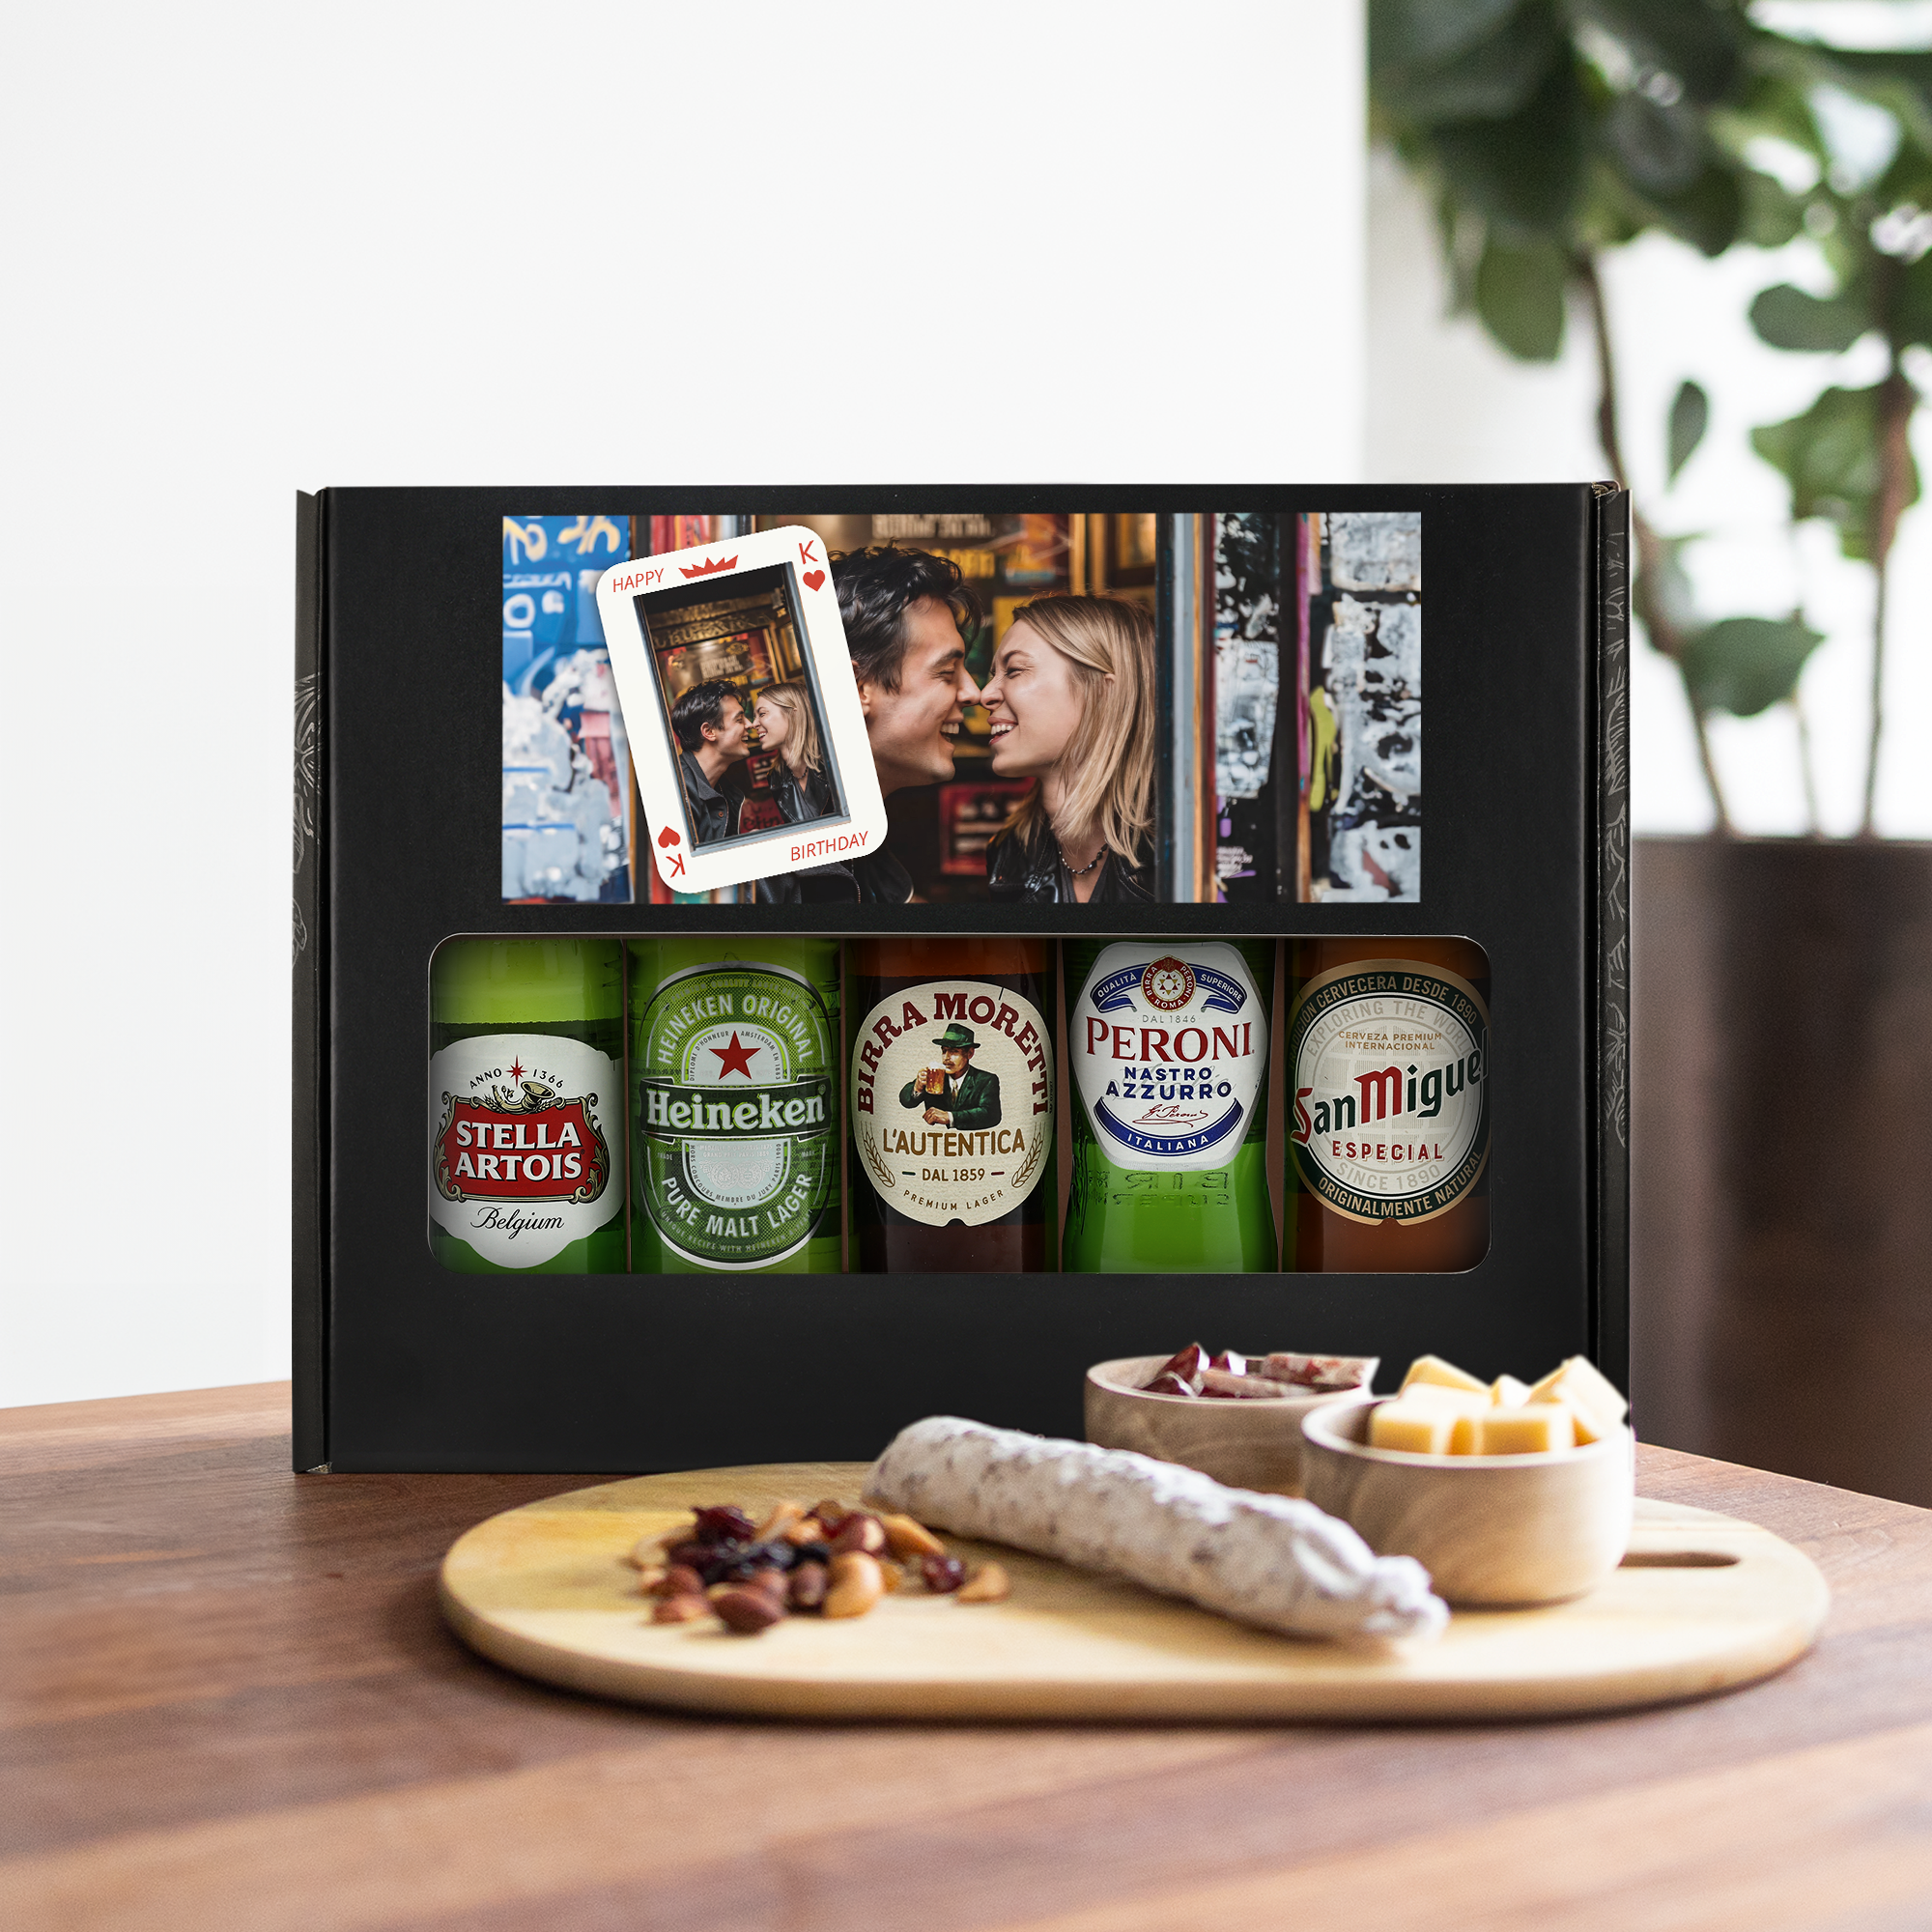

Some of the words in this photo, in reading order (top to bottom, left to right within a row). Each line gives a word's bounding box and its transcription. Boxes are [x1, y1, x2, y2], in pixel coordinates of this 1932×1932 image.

[798, 539, 818, 565] K
[612, 568, 665, 593] HAPPY
[790, 831, 869, 862] BIRTHDAY
[666, 853, 686, 878] K
[1097, 973, 1137, 997] QUALITÀ
[1200, 974, 1242, 1003] SUPERIORE
[1144, 966, 1158, 996] BIRRA
[1180, 965, 1194, 998] PERONI
[1153, 999, 1184, 1010] ROMA
[1316, 976, 1398, 1009] CERVECERA
[1403, 977, 1450, 1002] DESDE
[1452, 993, 1478, 1025] 1890
[657, 994, 733, 1065] HEINEKEN
[743, 994, 814, 1064] ORIGINAL
[1142, 1014, 1165, 1025] DAL
[1169, 1014, 1197, 1025] 1846
[1306, 1000, 1384, 1057] EXPLORING
[1392, 1000, 1428, 1020] THE
[1086, 1015, 1253, 1063] PERONI
[1338, 1031, 1389, 1042] CERVEZA
[1393, 1031, 1443, 1042] PREMIUM
[1344, 1040, 1436, 1051] INTERNACIONAL
[690, 1050, 698, 1081] DIPLOME
[695, 1030, 729, 1051] D'HONNEUR
[740, 1030, 777, 1053] AMSTERDAM
[772, 1051, 781, 1062] EN
[857, 1001, 928, 1115] BIRRA
[933, 993, 1049, 1116] MORETTI
[469, 1068, 503, 1090] ANNO
[532, 1068, 564, 1089] 1366
[1124, 1065, 1212, 1082] NASTRO
[1105, 1081, 1232, 1100] AZZURRO
[646, 1087, 826, 1131] Heineken
[456, 1121, 582, 1151] STELLA
[883, 1127, 1026, 1157] L'AUTENTICA
[1127, 1133, 1209, 1152] ITALIANA
[1332, 1140, 1445, 1162] ESPECIAL
[454, 1151, 582, 1182] ARTOIS
[922, 1168, 949, 1182] DAL
[952, 1168, 985, 1182] 1859
[1336, 1161, 1388, 1191] SINCE
[1397, 1163, 1440, 1190] 1890
[691, 1164, 714, 1199] CONCOURS
[747, 1193, 757, 1203] DU
[758, 1182, 774, 1197] JURY
[1318, 1177, 1434, 1217] ORIGINALMENTE
[1434, 1151, 1482, 1204] NATURAL
[661, 1177, 701, 1227] PURE
[705, 1213, 759, 1238] MALT
[767, 1173, 813, 1229] LAGER
[903, 1189, 958, 1210] PREMIUM
[966, 1189, 1005, 1209] LAGER
[469, 1206, 565, 1239] Belgium
[661, 1210, 687, 1237] UNIQUE
[719, 1242, 743, 1253] WITH
